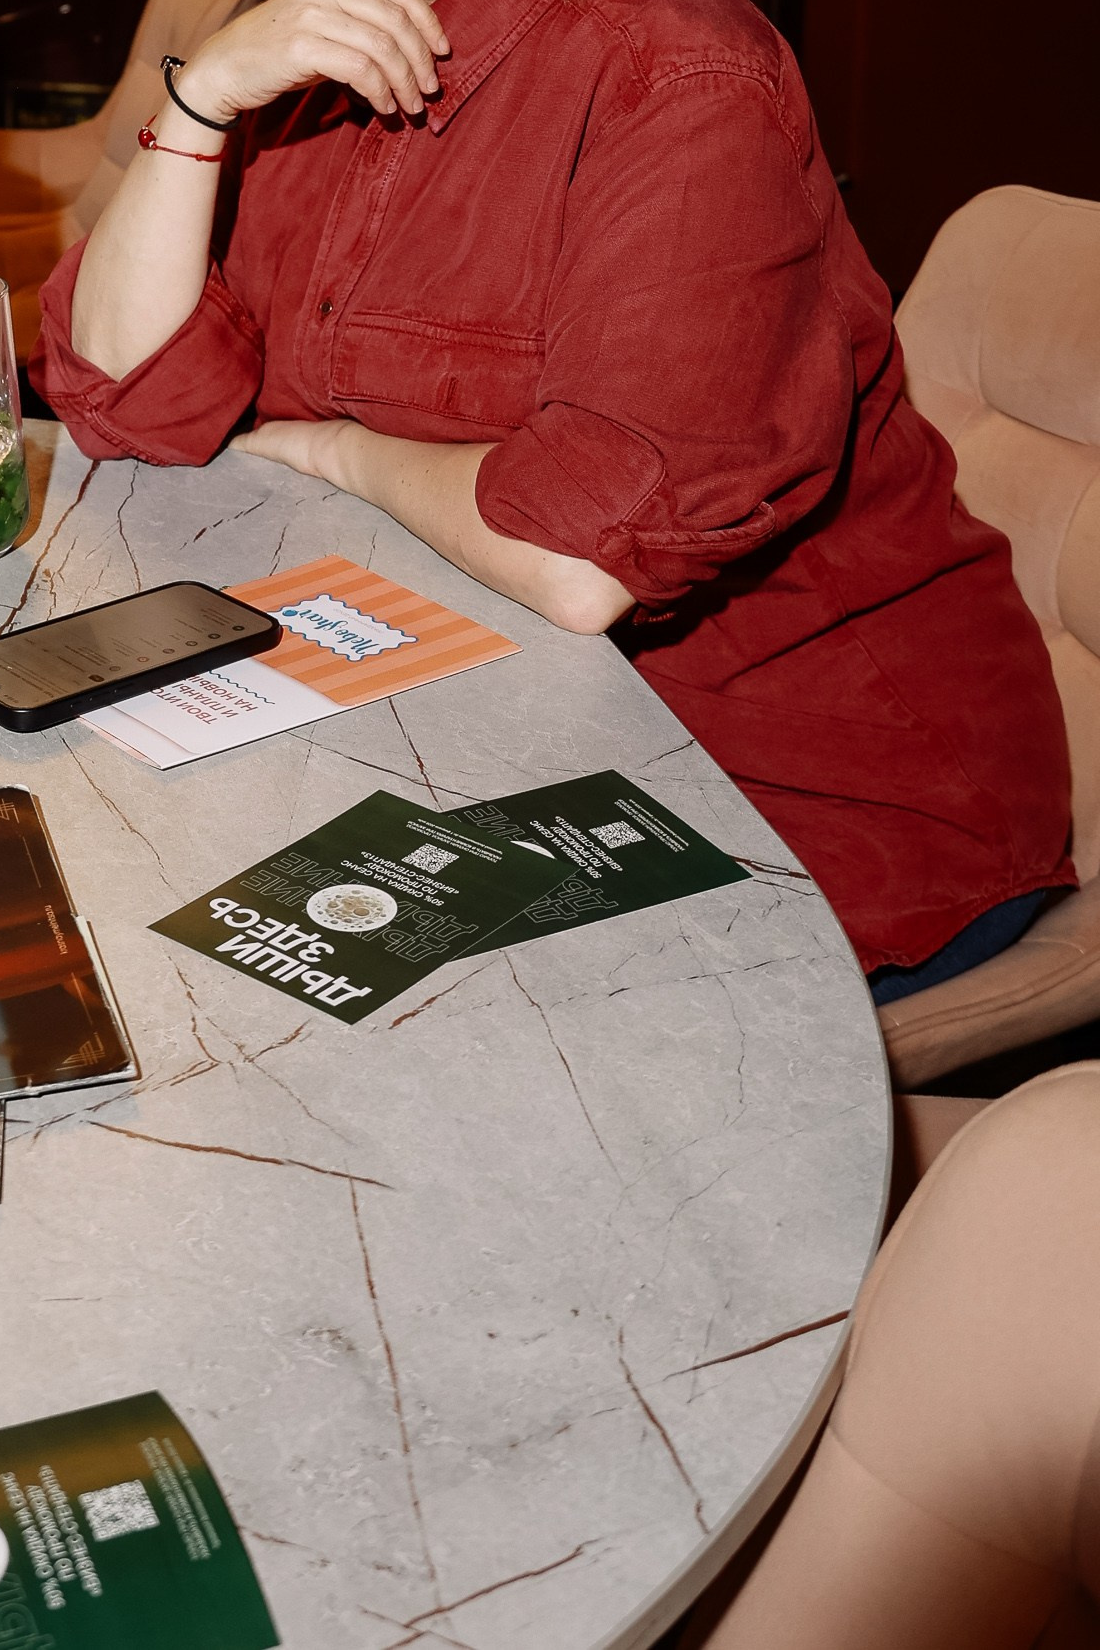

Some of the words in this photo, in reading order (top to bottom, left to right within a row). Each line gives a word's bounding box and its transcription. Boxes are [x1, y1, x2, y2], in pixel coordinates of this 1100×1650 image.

[150, 688, 181, 703] ИТО
[172, 683, 227, 711] ПЛАНЫ
[176, 702, 217, 724] ТВОИ
[220, 709, 239, 718] И
[234, 699, 258, 711] НА
[530, 821, 554, 838] СЕАНС
[550, 827, 593, 858] ПРОМОКОДУ
[551, 837, 564, 846] НА
[561, 845, 588, 866] СКИДКА
[589, 858, 603, 867] ПО
[341, 860, 373, 875] СЕАНС
[364, 863, 422, 888] ПРОМОКОДУ
[585, 866, 602, 878] 50%
[374, 874, 388, 882] НА
[270, 852, 478, 942] ДЫНИЕ
[388, 880, 423, 897] СКИДКА
[422, 886, 438, 894] ПО
[424, 896, 444, 906] 50%
[240, 870, 449, 962] ДЫНИЕ
[210, 898, 334, 962] ЗДЕСЬ
[215, 934, 372, 1006] ДЫШИ
[15, 1507, 34, 1526] НА
[25, 1485, 66, 1557] ПРОМОКОДУ
[54, 1558, 76, 1581] ПО
